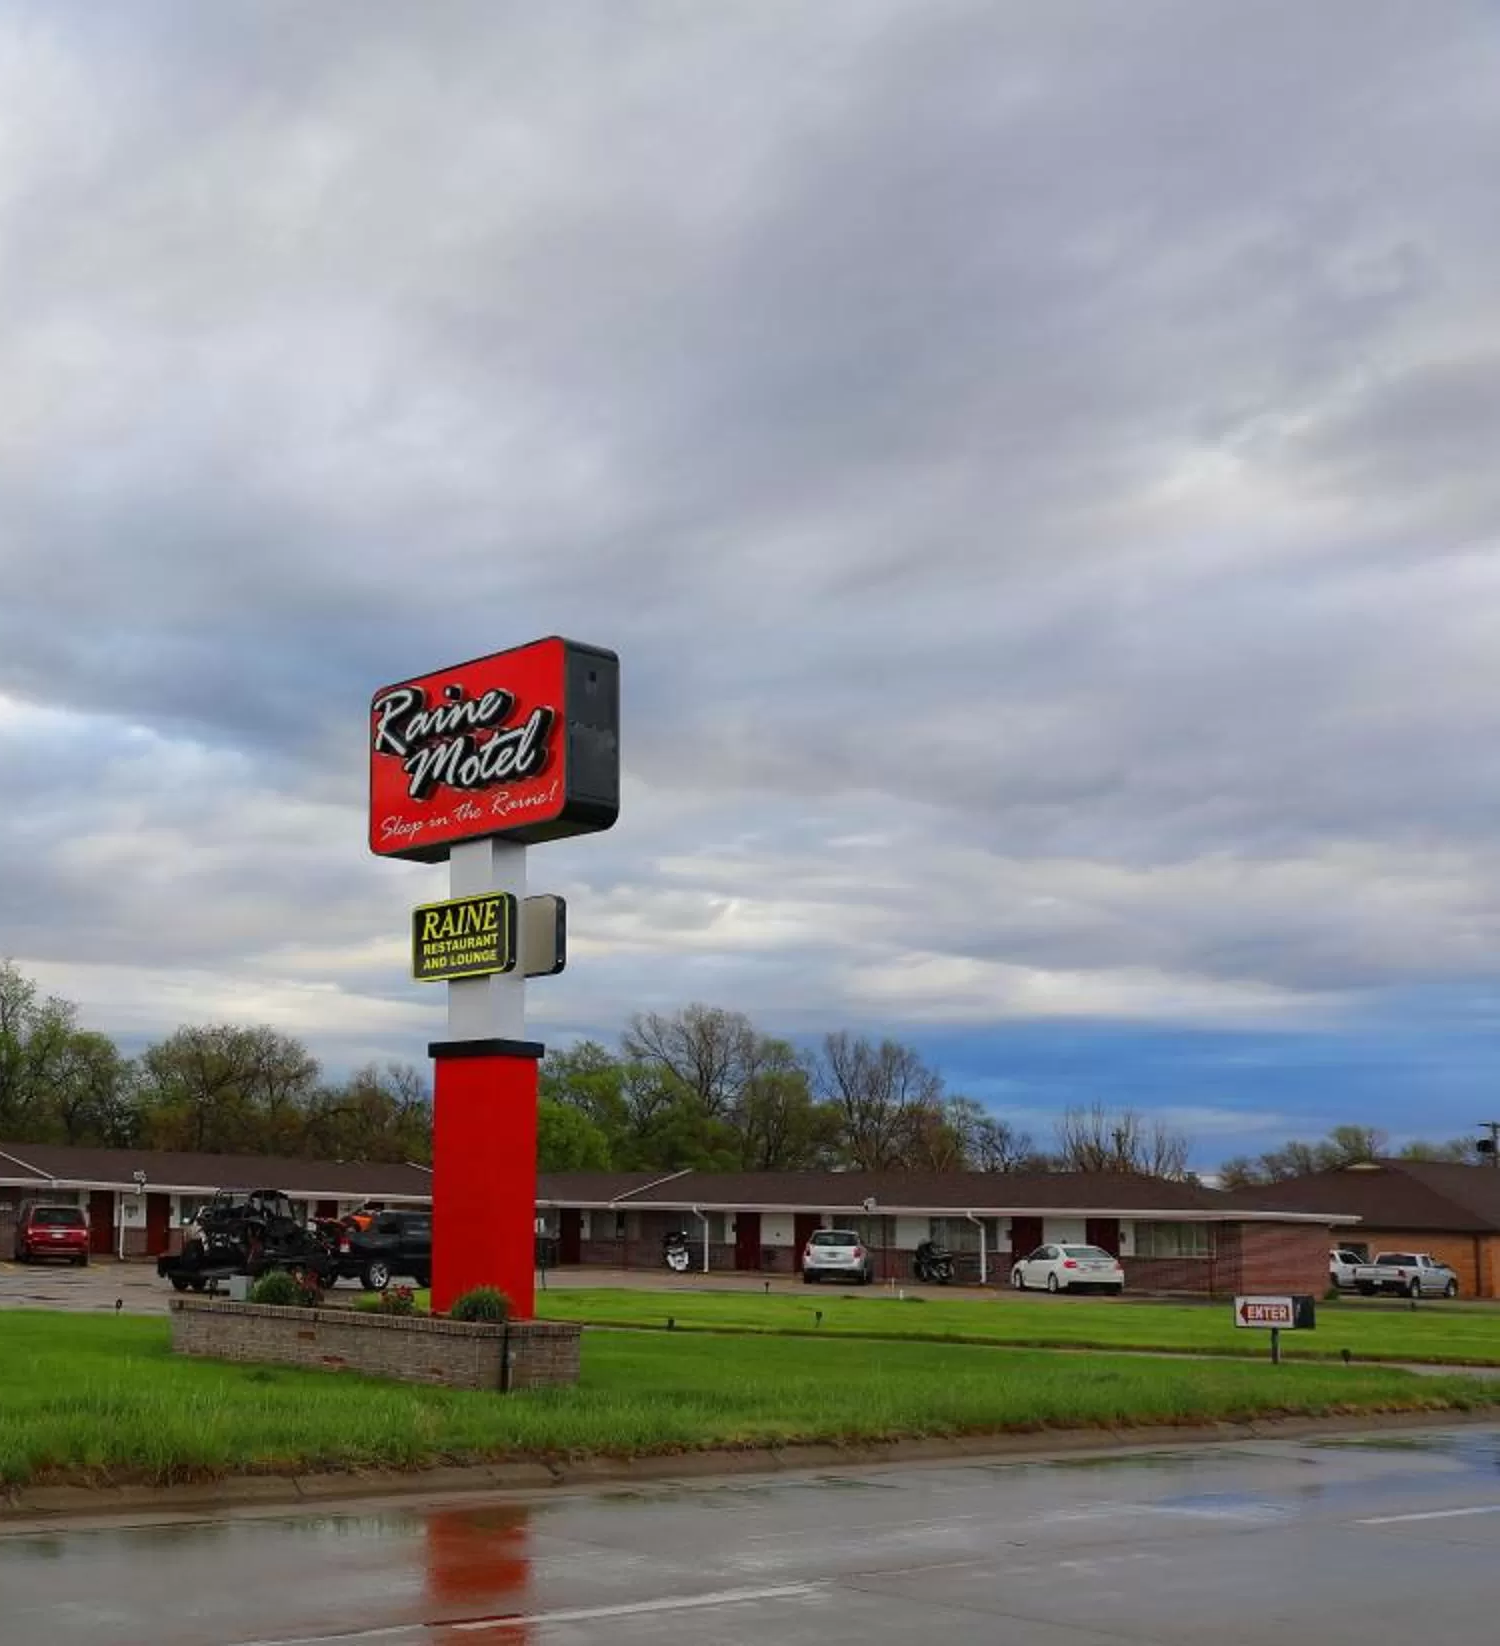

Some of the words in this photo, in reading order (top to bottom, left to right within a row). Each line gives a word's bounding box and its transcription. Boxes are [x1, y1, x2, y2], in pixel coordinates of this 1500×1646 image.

[373, 686, 508, 756] Raine
[405, 707, 550, 799] Motel
[380, 815, 425, 842] Sleep
[427, 811, 450, 829] in
[453, 799, 482, 822] the
[491, 780, 558, 817] Raine!
[421, 900, 500, 941] RAINE
[423, 933, 499, 956] RESTAURANT
[423, 957, 448, 970] AND
[450, 949, 498, 968] LOUNGE
[1247, 1305, 1288, 1320] ENTER
